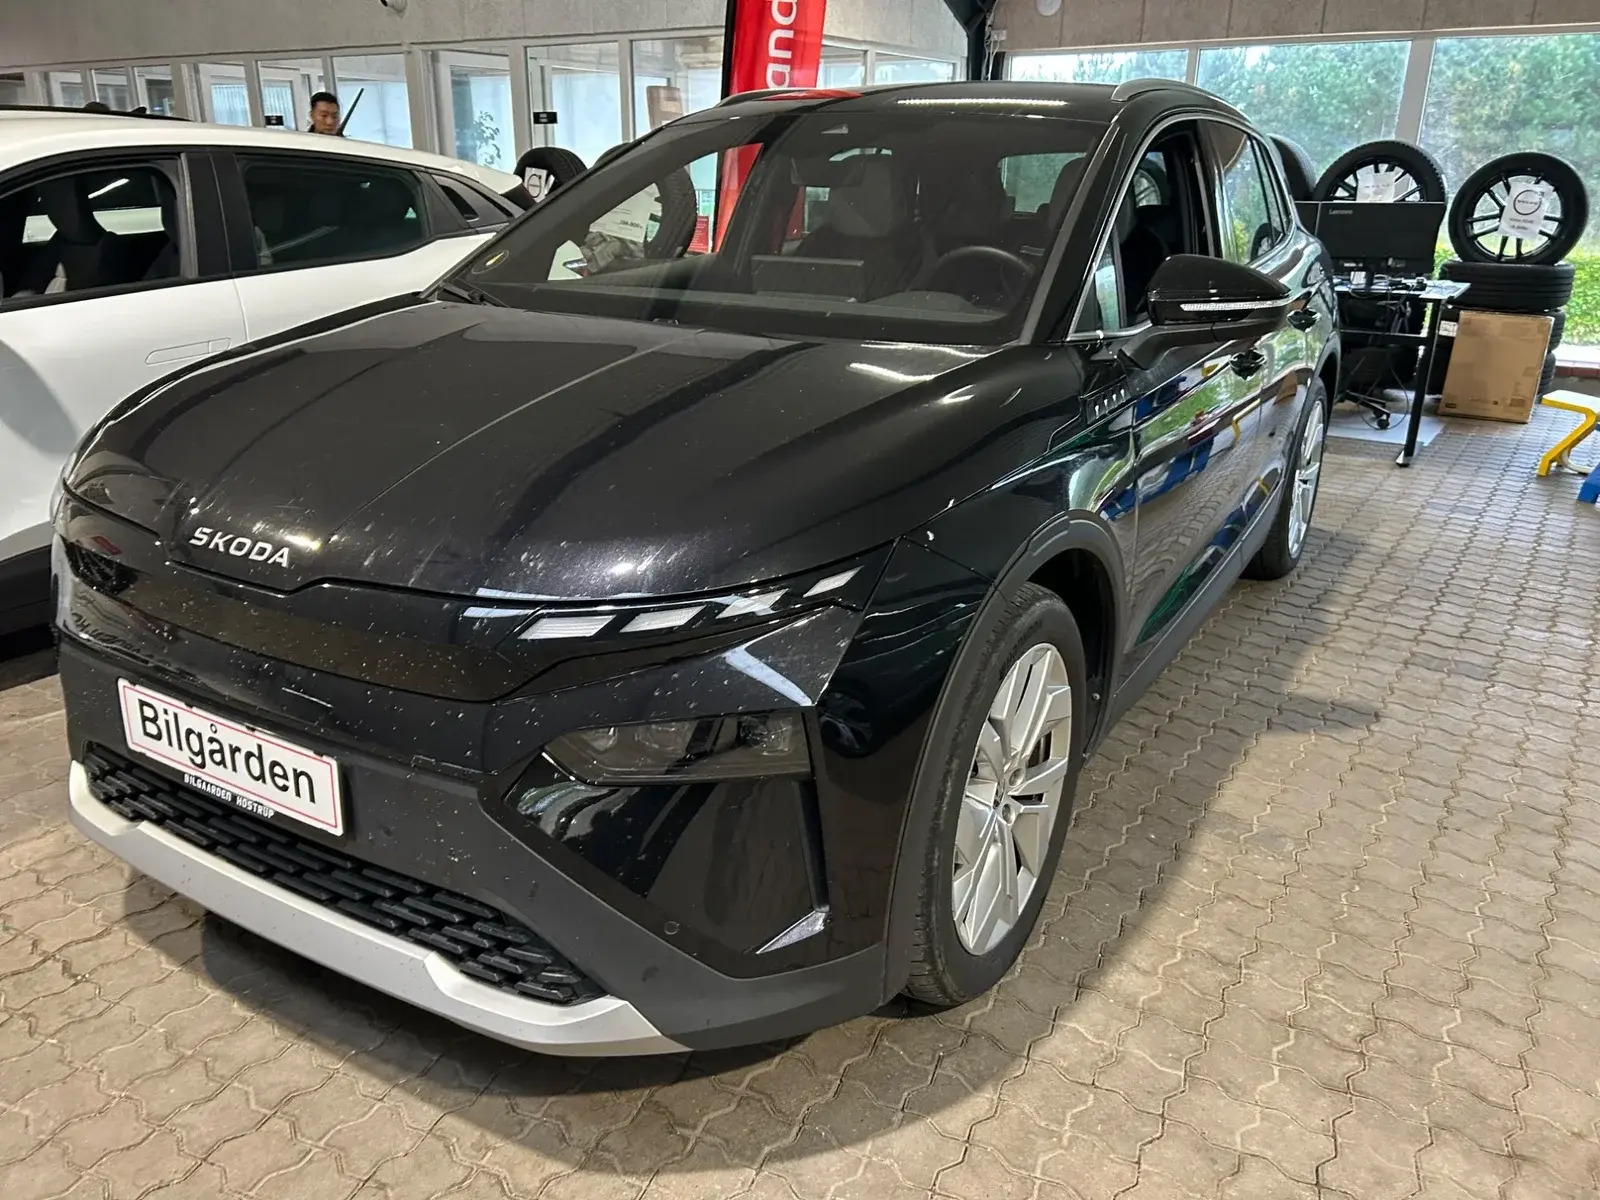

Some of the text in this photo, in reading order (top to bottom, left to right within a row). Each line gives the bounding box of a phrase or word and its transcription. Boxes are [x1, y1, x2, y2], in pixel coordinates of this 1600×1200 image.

[137, 698, 316, 804] Bilgården
[183, 773, 275, 819] BILGAARDEN HOSTRUP
